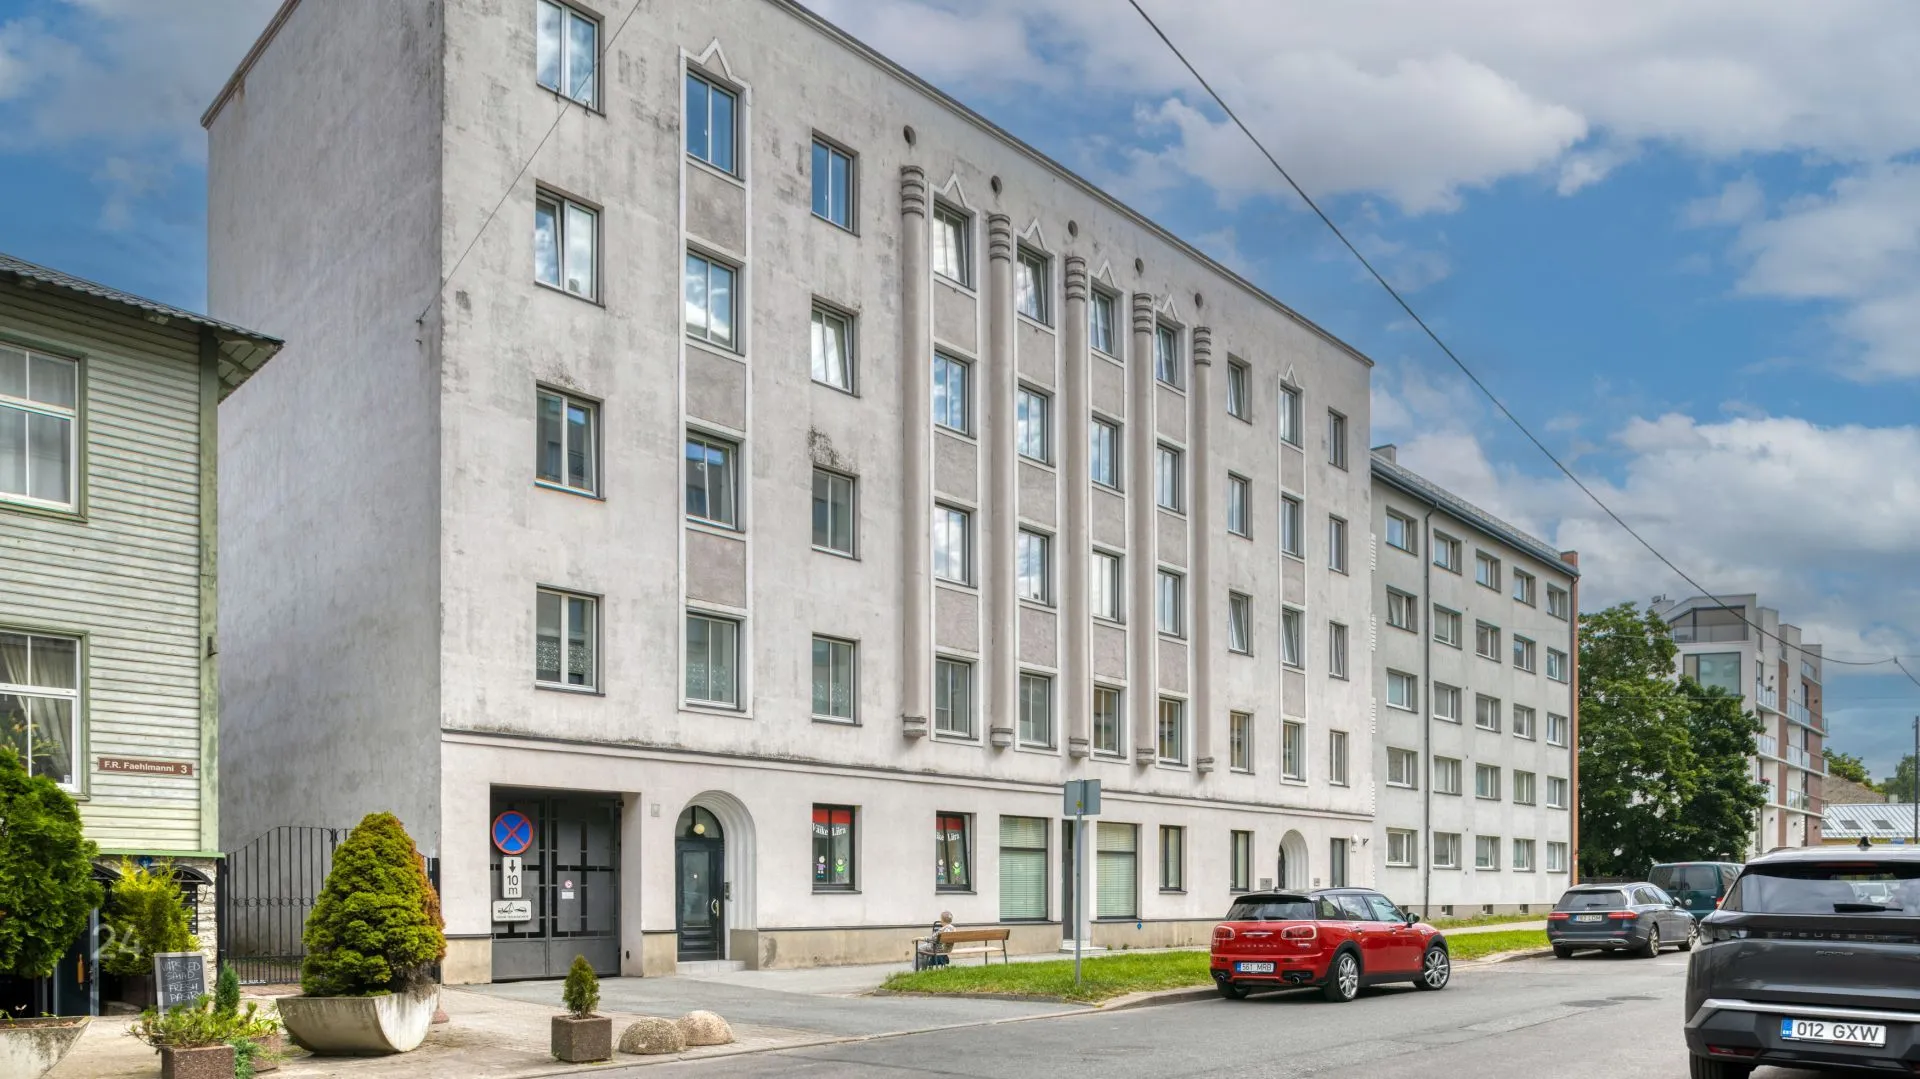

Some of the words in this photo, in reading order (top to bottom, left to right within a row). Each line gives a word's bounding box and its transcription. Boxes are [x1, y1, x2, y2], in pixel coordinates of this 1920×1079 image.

[104, 760, 121, 769] F.R.
[123, 761, 174, 772] Faehlmanni
[180, 765, 187, 774] 3
[507, 875, 518, 886] 10
[168, 983, 199, 992] FRESH
[1797, 1022, 1825, 1037] 012
[1833, 1024, 1879, 1041] GXW
